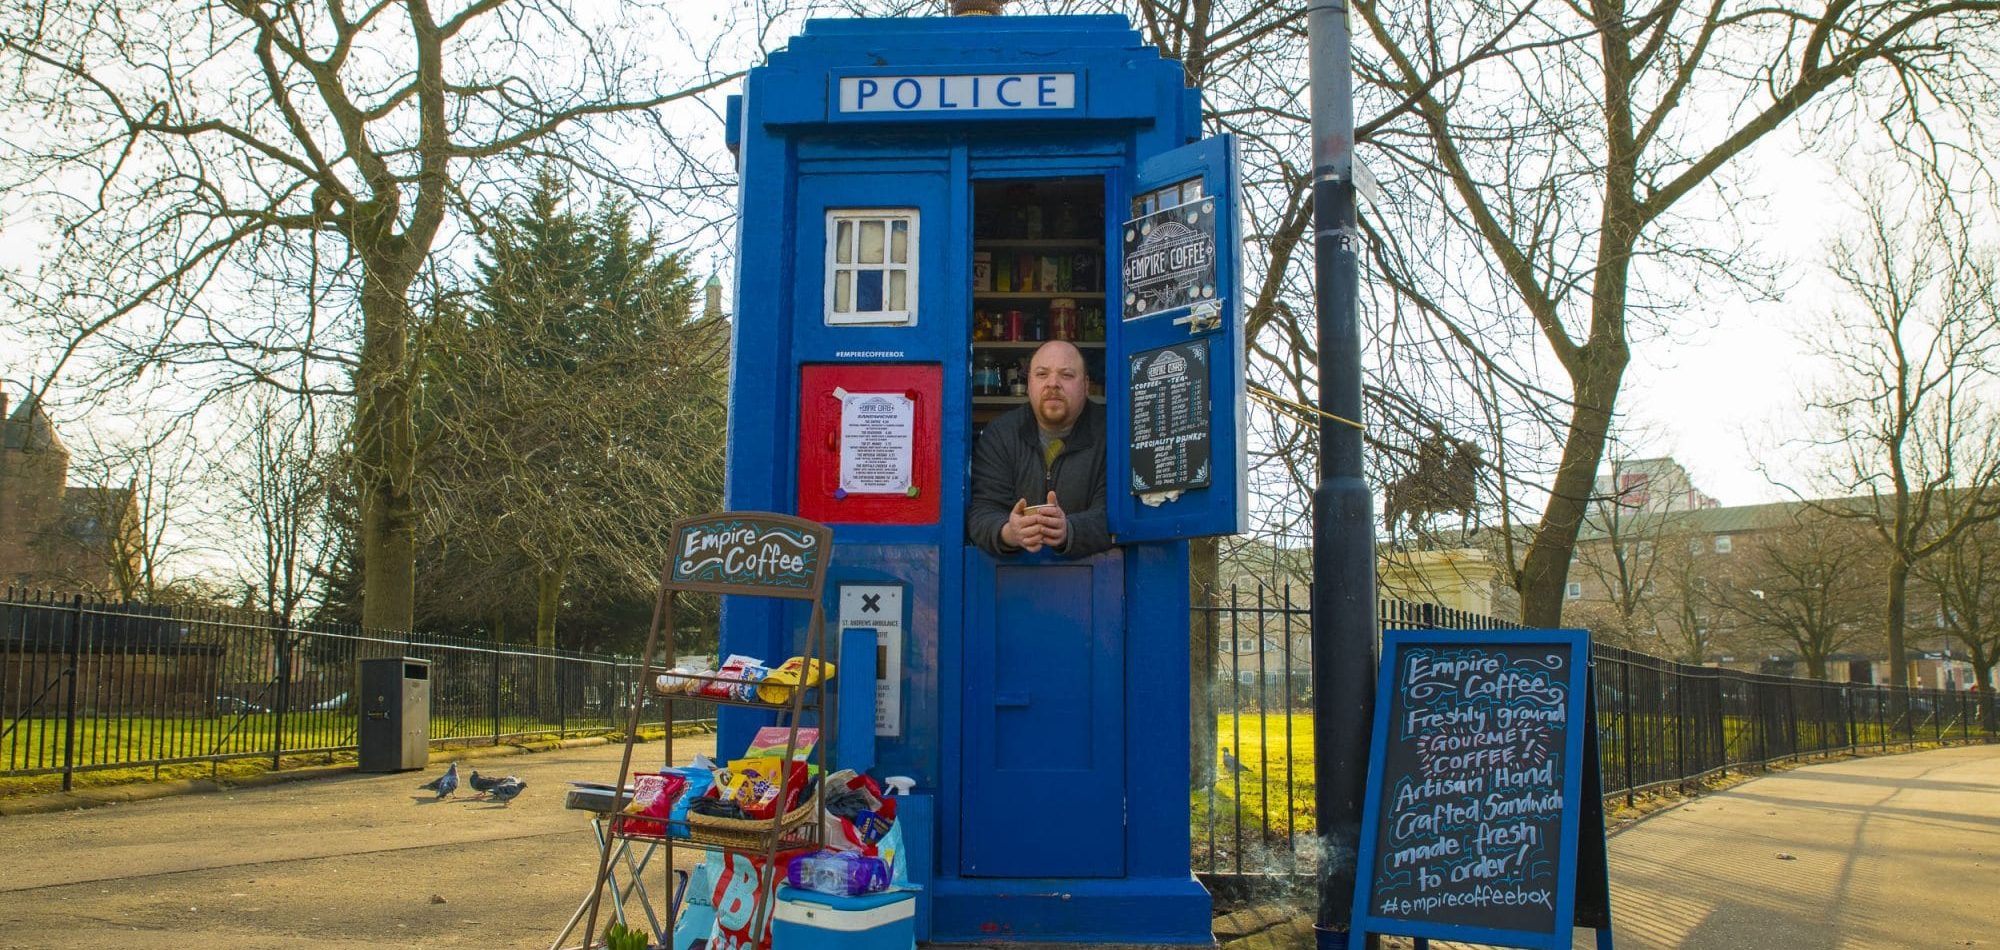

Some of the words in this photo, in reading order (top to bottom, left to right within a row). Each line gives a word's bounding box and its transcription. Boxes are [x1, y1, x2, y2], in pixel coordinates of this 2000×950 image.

[857, 76, 1056, 110] POLICE
[1131, 252, 1166, 281] EMPIRE
[1170, 241, 1205, 270] COFFEE
[835, 350, 904, 358] #EMPIRECOFFEEBOX
[1135, 437, 1175, 450] SPECIALITY
[684, 527, 756, 558] Empire
[724, 543, 804, 577] Coffee
[1408, 655, 1500, 684] Empire
[1465, 673, 1549, 700] Coffee
[1408, 706, 1486, 734] Freshly
[1497, 703, 1566, 729] ground
[1430, 728, 1535, 752] GOURMET
[1396, 777, 1483, 812] Artisan
[1495, 760, 1553, 788] Hand
[1396, 800, 1480, 840] Crafted
[1394, 837, 1460, 868] made
[1472, 822, 1536, 855] fresh
[1418, 867, 1441, 892] to
[1451, 844, 1530, 883] order!
[1380, 885, 1553, 915] #empirecoffeebox
